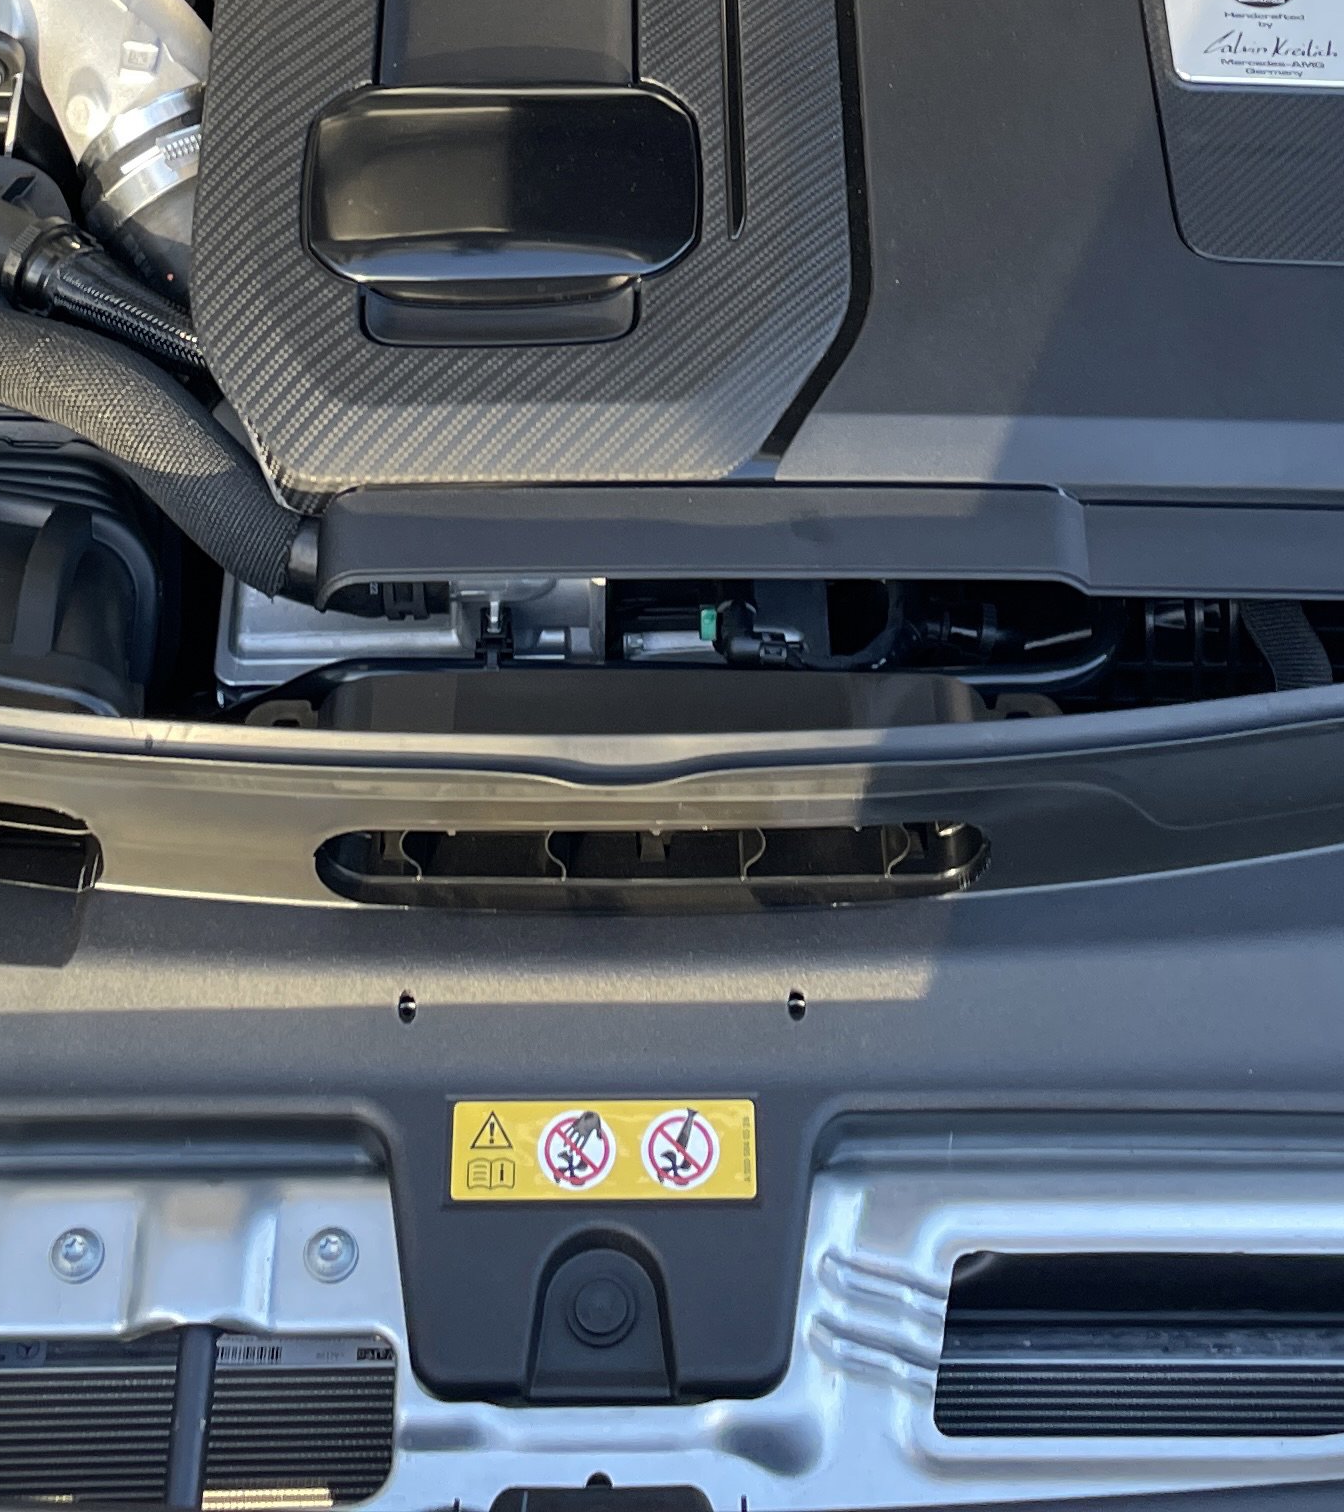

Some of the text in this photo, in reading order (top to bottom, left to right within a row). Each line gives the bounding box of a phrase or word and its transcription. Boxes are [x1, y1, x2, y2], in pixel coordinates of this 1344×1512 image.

[1224, 11, 1305, 21] Handcrafted
[1258, 21, 1272, 29] by
[1220, 58, 1325, 69] Mercedes-AMG
[1245, 68, 1303, 77] Germany
